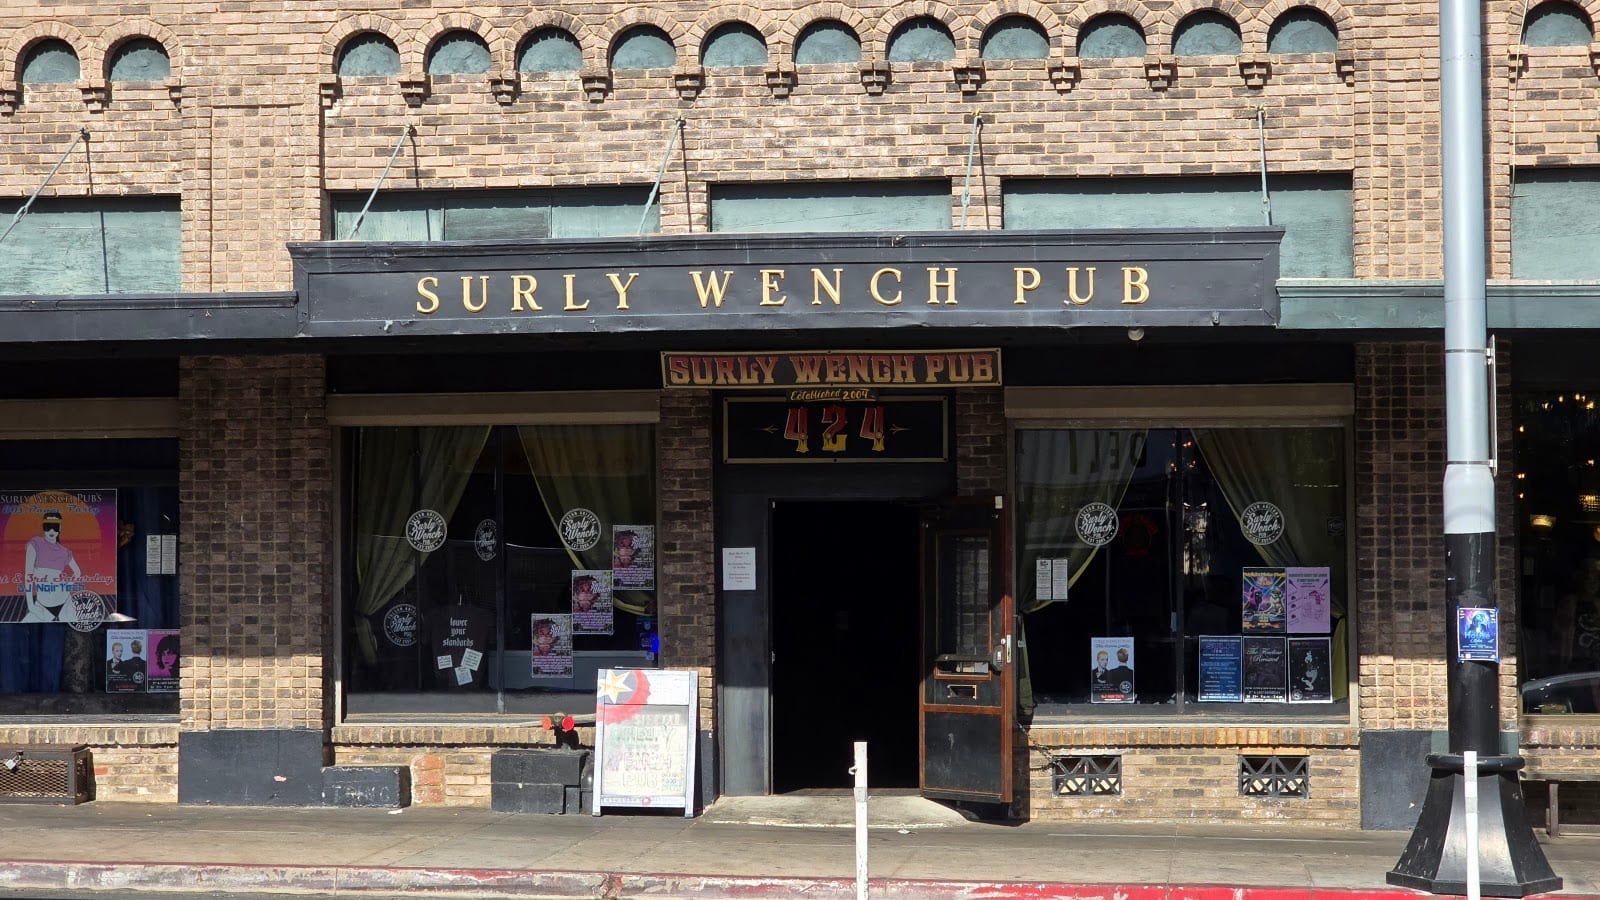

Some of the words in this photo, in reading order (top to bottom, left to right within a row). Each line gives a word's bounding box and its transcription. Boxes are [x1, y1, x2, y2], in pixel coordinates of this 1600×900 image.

[416, 272, 639, 313] SURLY
[689, 266, 958, 308] WENCH
[1013, 266, 1150, 305] PUB
[668, 355, 779, 385] SURLY
[789, 354, 916, 384] WENCH
[924, 352, 994, 383] PUB
[790, 389, 840, 401] Established
[784, 405, 885, 452] 424
[567, 516, 590, 530] Surly
[1084, 511, 1109, 525] Surly
[1247, 510, 1273, 524] Surly
[413, 519, 436, 531] Surly
[1081, 520, 1114, 534] Wench
[1246, 519, 1278, 533] Wench
[411, 527, 443, 540] Wench
[565, 526, 596, 540] Wench
[450, 616, 468, 627] lower
[451, 628, 467, 637] your
[442, 637, 474, 648] standards
